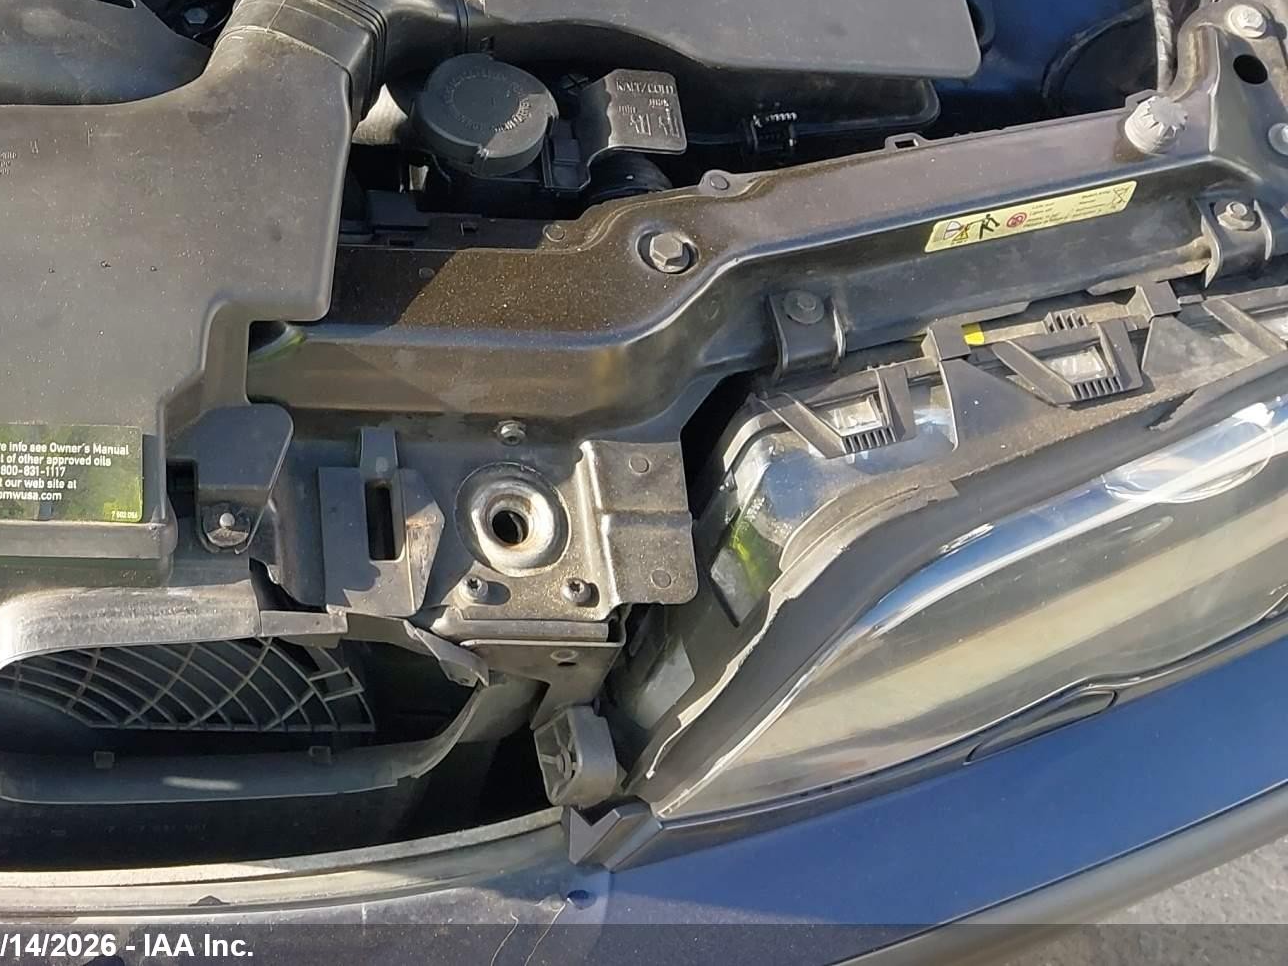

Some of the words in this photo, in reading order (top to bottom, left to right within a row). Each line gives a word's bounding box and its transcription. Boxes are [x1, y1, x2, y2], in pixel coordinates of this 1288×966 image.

[9, 441, 27, 452] info
[30, 444, 47, 453] see
[93, 444, 129, 455] Manual
[7, 453, 17, 464] of
[18, 454, 44, 465] other
[46, 454, 91, 467] approved
[94, 455, 112, 467] oils
[5, 480, 22, 488] our
[24, 478, 45, 489] web
[47, 479, 65, 489] site
[67, 479, 77, 489] at
